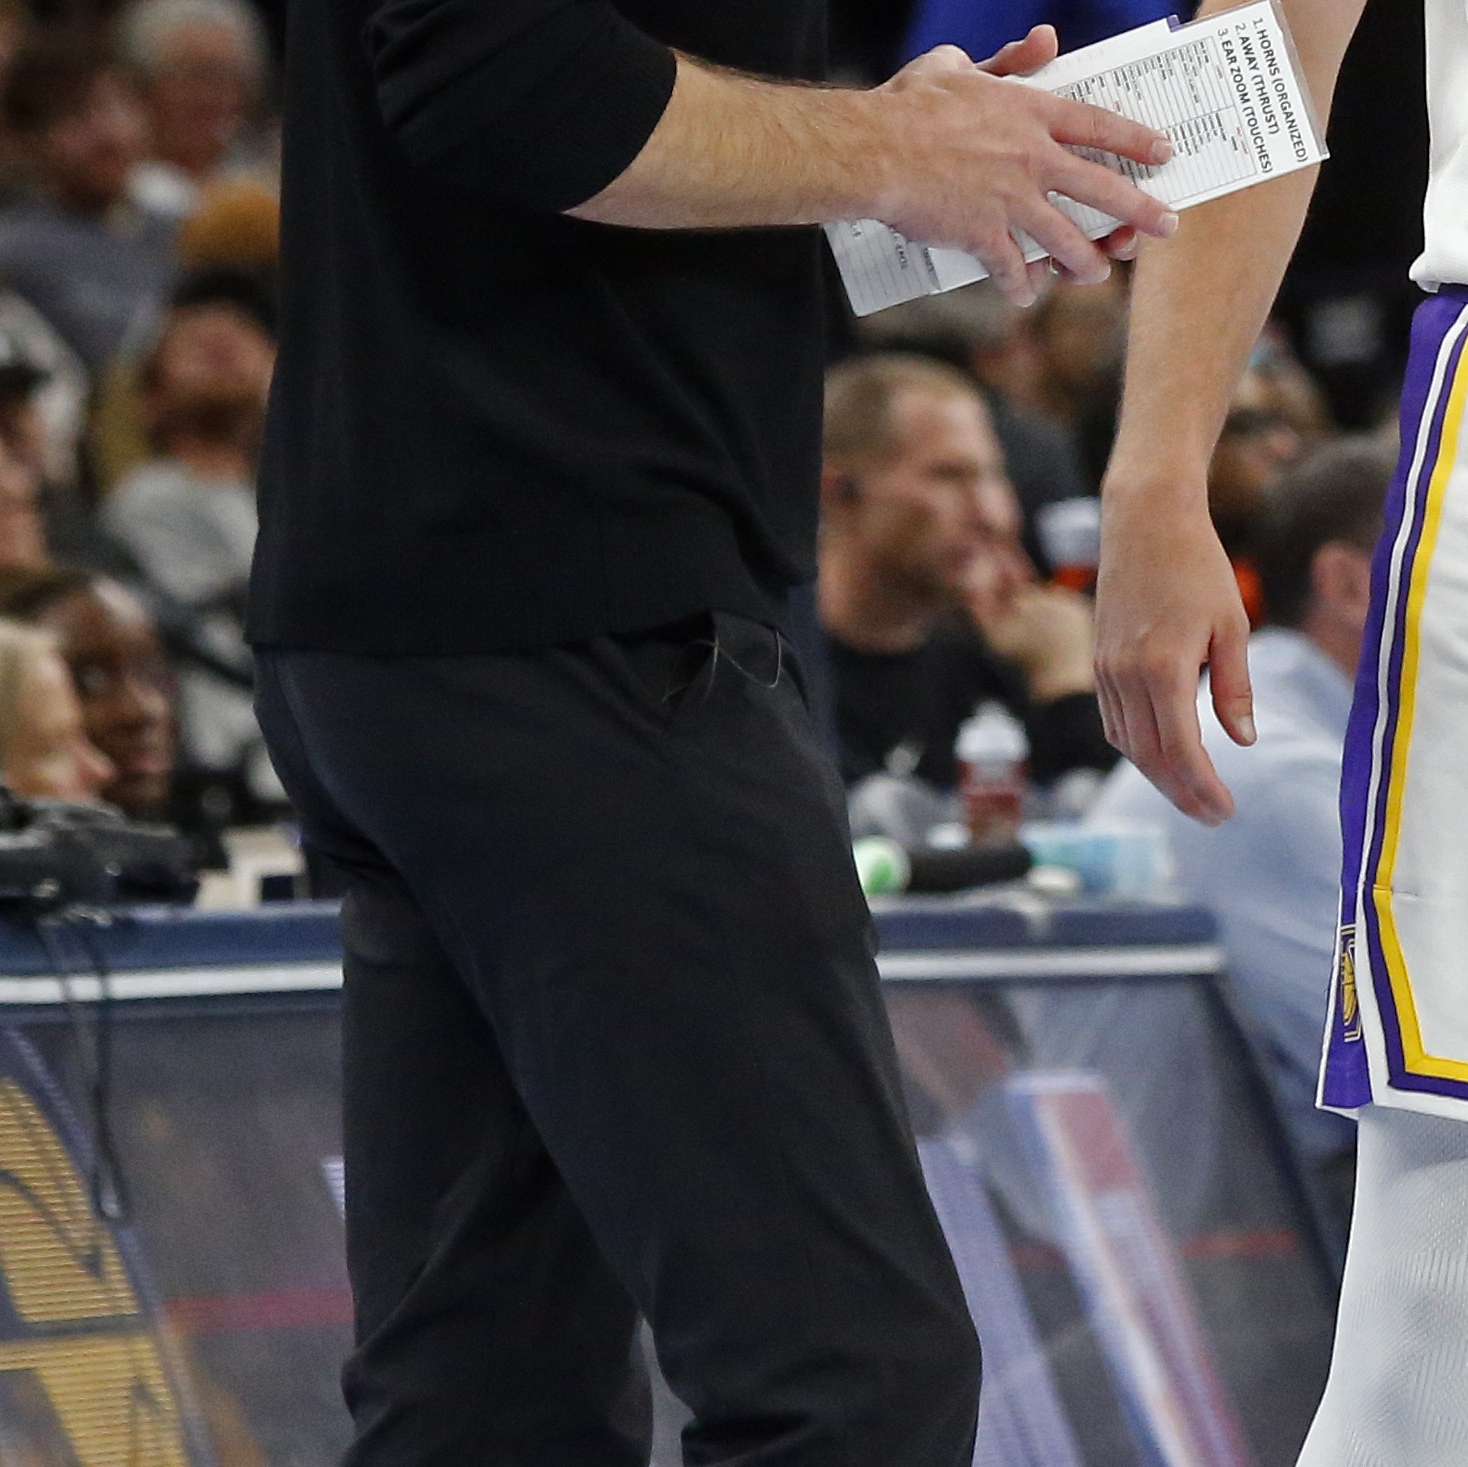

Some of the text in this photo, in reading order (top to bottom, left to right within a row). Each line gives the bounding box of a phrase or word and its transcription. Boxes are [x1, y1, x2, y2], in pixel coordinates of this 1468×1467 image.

[1221, 40, 1238, 66] EAR
[1230, 66, 1251, 105] ZOOM
[1242, 106, 1274, 174] (TOUCHES)
[1239, 36, 1260, 75] AWAY
[1251, 74, 1281, 135] (THRUST)
[1256, 28, 1281, 76] HORNS
[1271, 77, 1309, 163] (ORGANIZED)
